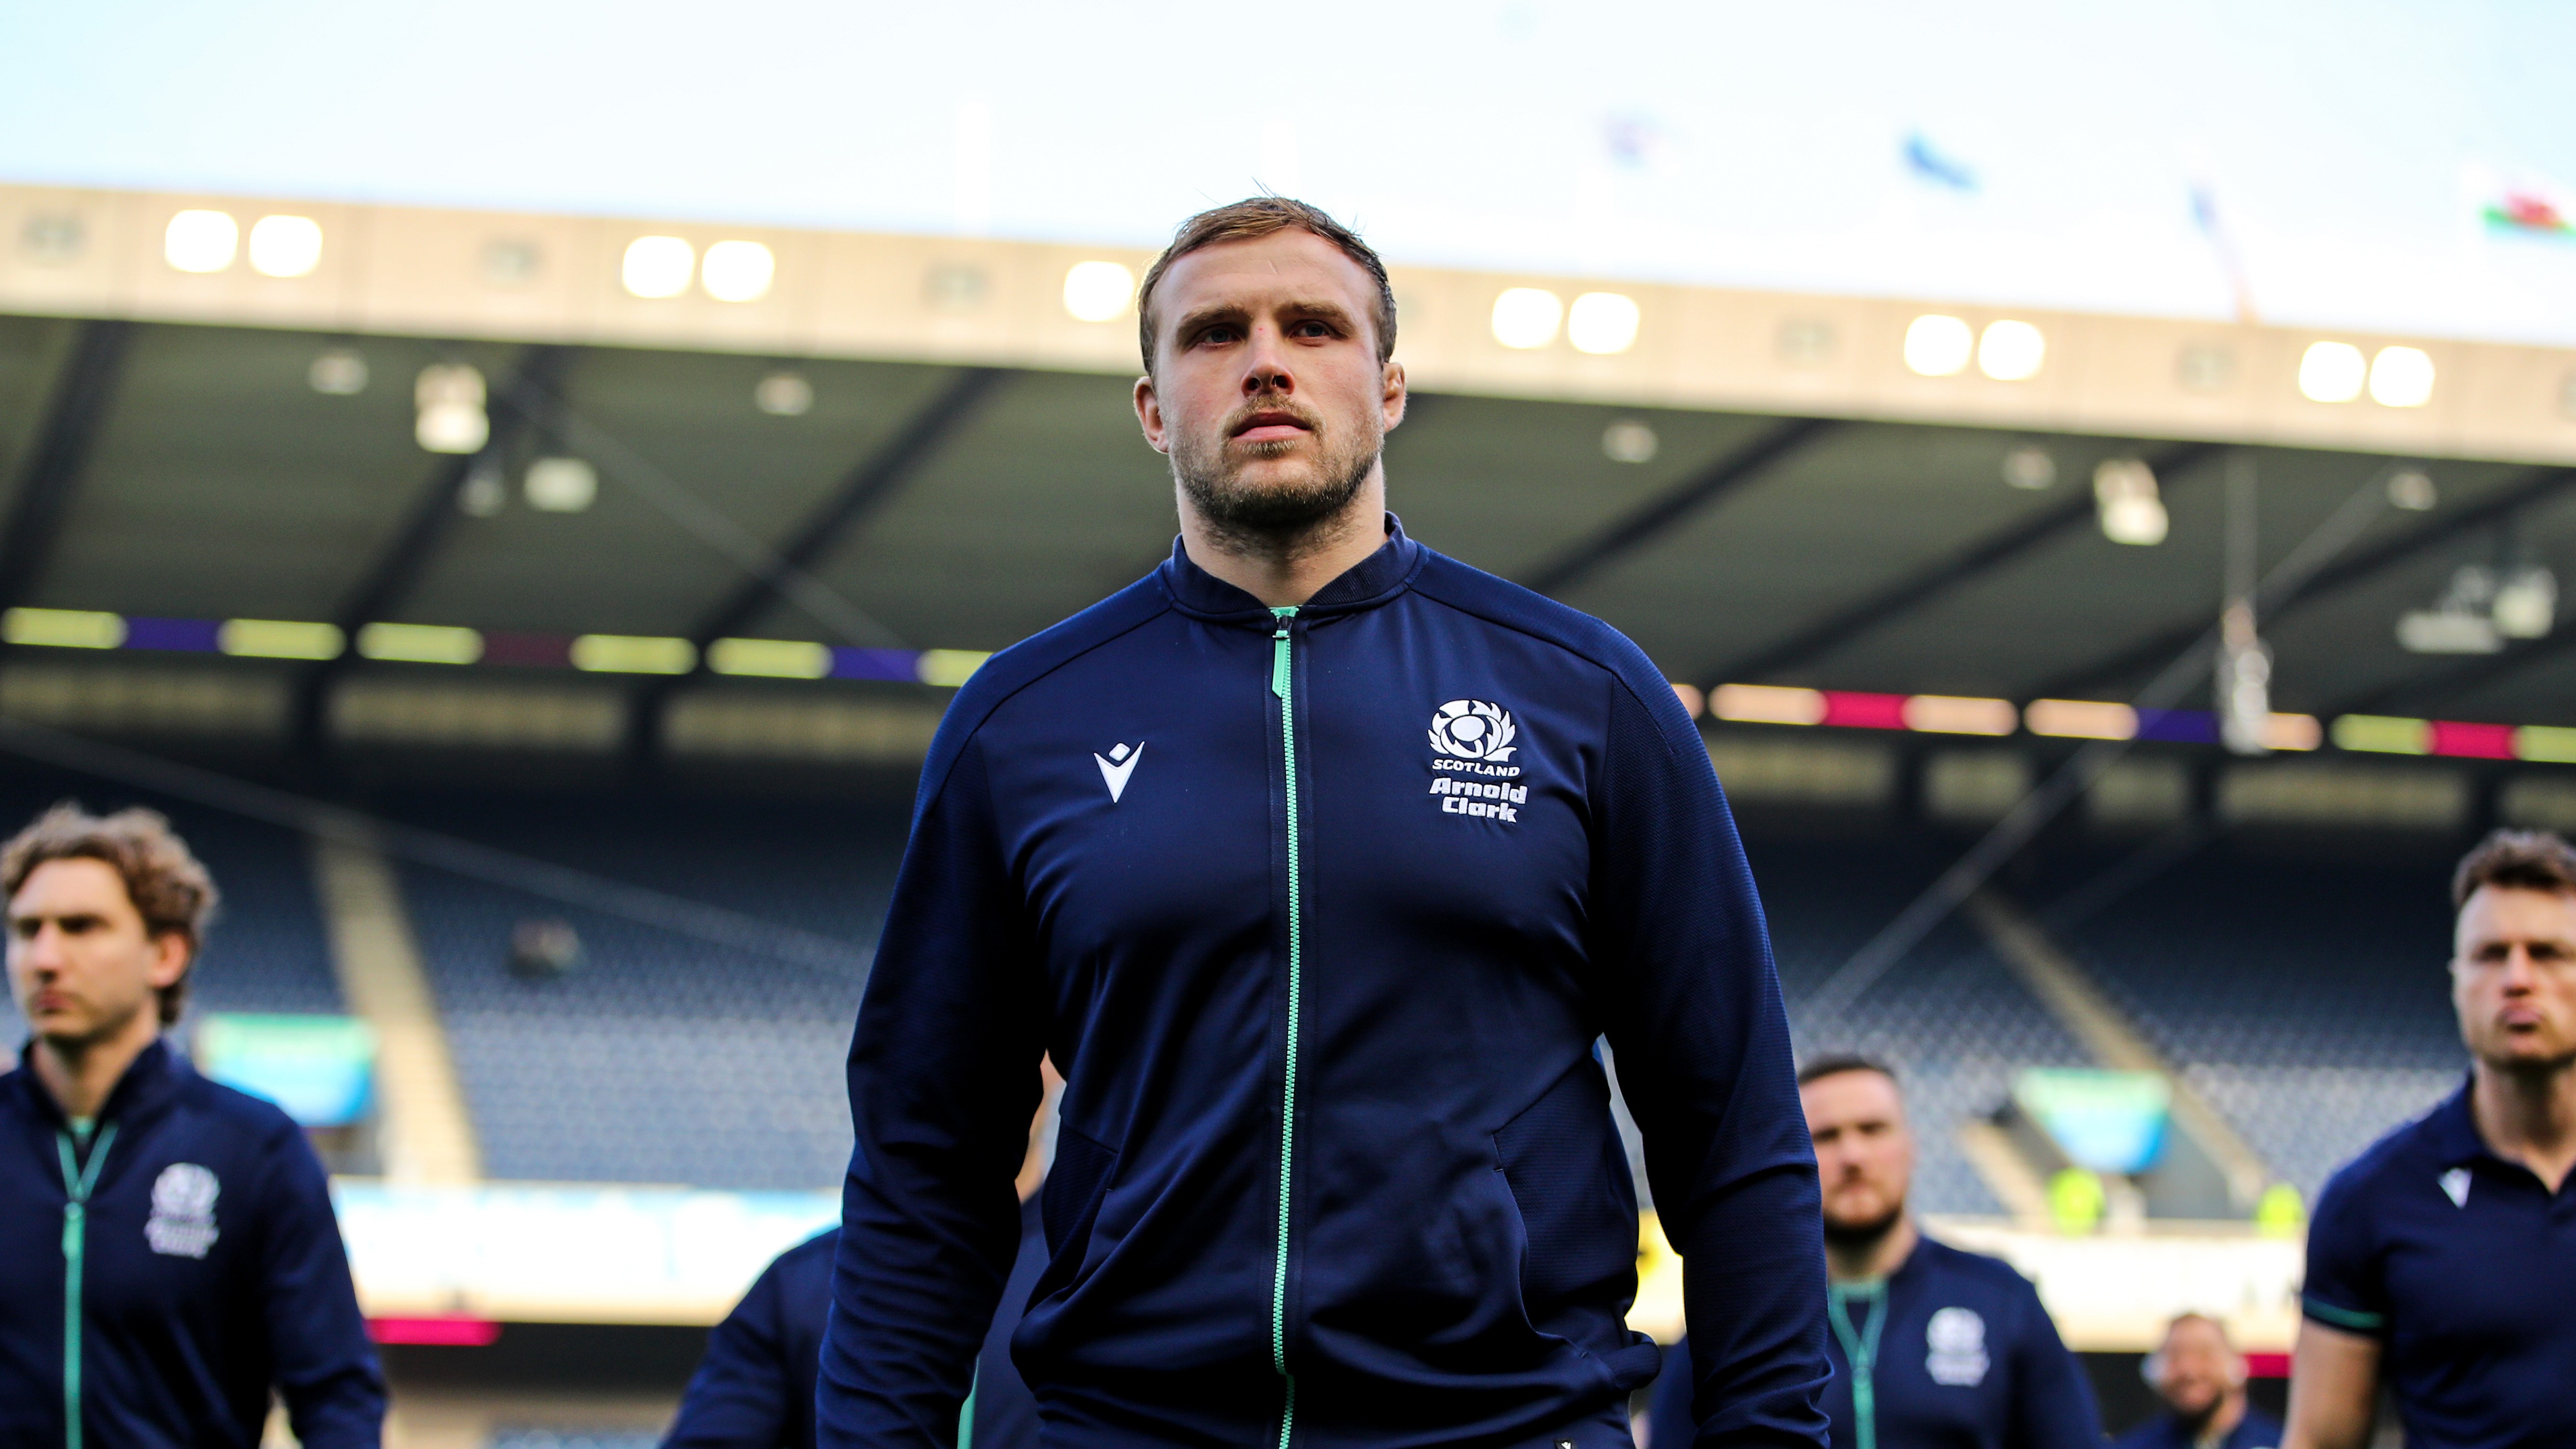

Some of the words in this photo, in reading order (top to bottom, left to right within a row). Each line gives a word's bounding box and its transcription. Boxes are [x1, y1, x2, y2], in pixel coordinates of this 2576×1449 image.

[1432, 759, 1520, 777] SCOTLAND
[1429, 778, 1528, 804] Arnold
[1442, 796, 1517, 823] Clark
